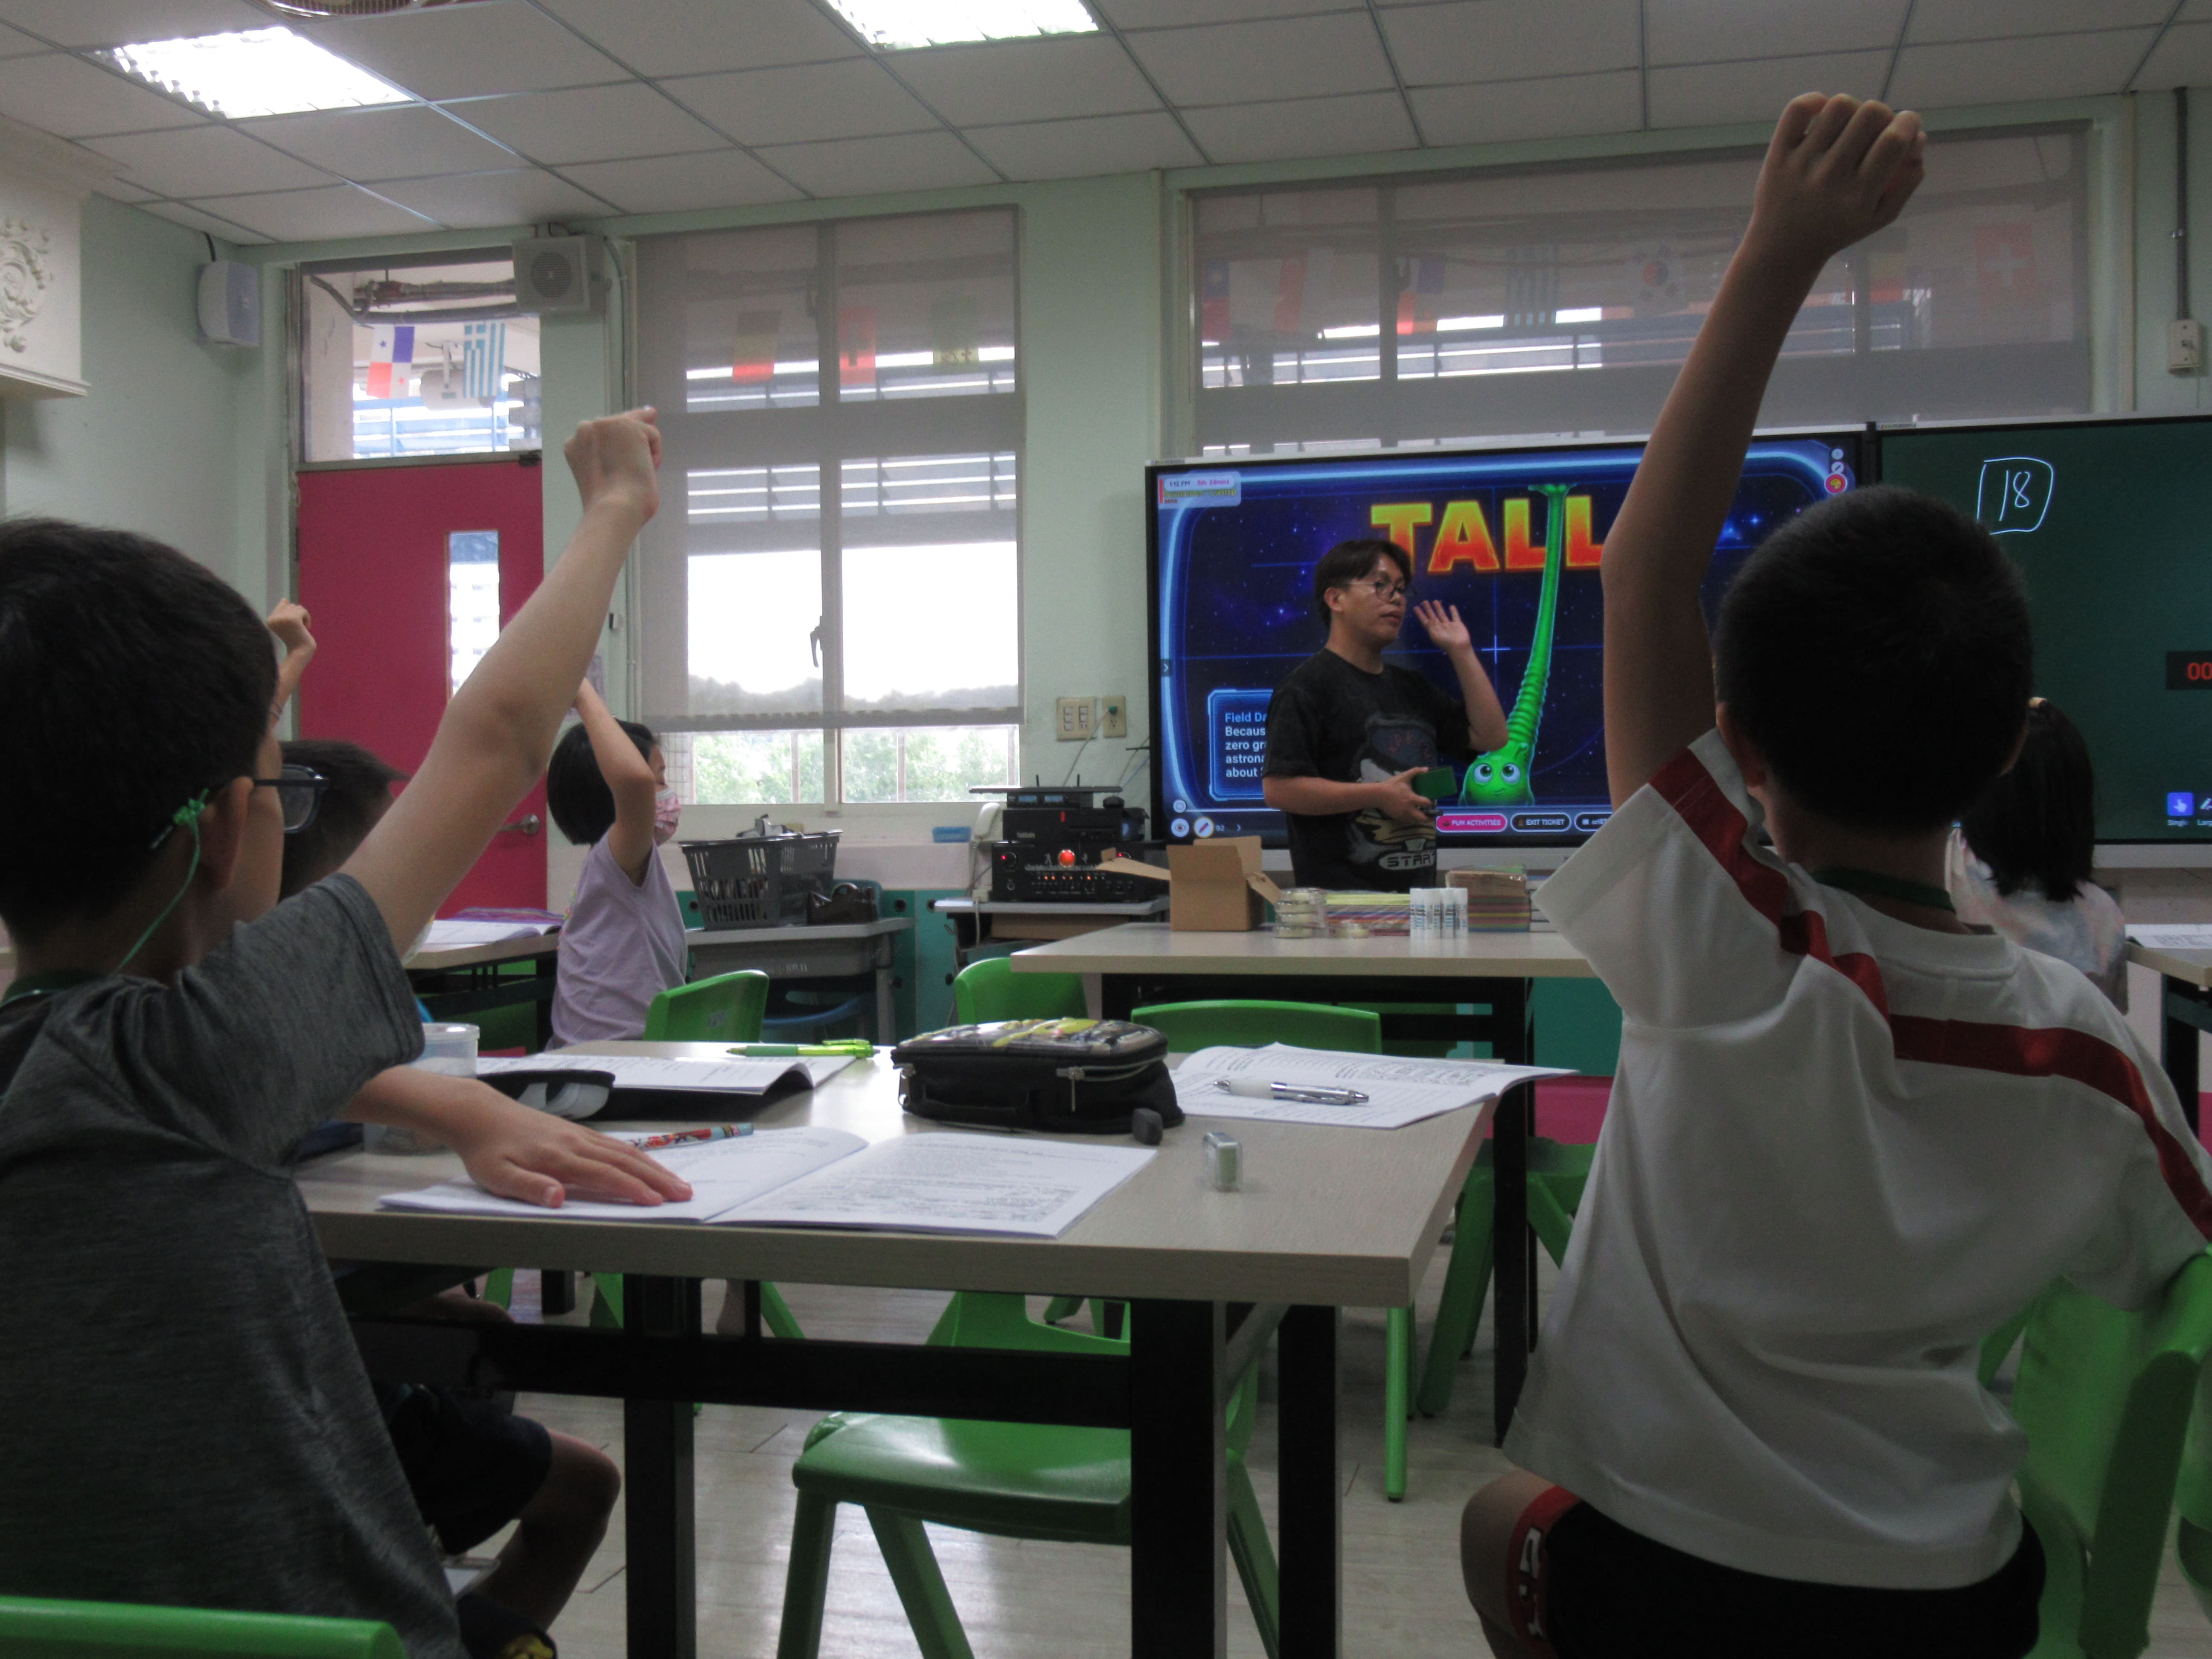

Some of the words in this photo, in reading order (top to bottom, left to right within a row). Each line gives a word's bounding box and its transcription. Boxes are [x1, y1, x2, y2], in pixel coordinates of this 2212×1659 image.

[1208, 489, 1237, 497] Camp
[1999, 469, 2031, 521] 18
[1371, 495, 1603, 573] TALL
[1225, 711, 1252, 723] Field
[1225, 741, 1250, 751] zero
[1252, 741, 1266, 753] gr
[1225, 767, 1258, 778] about
